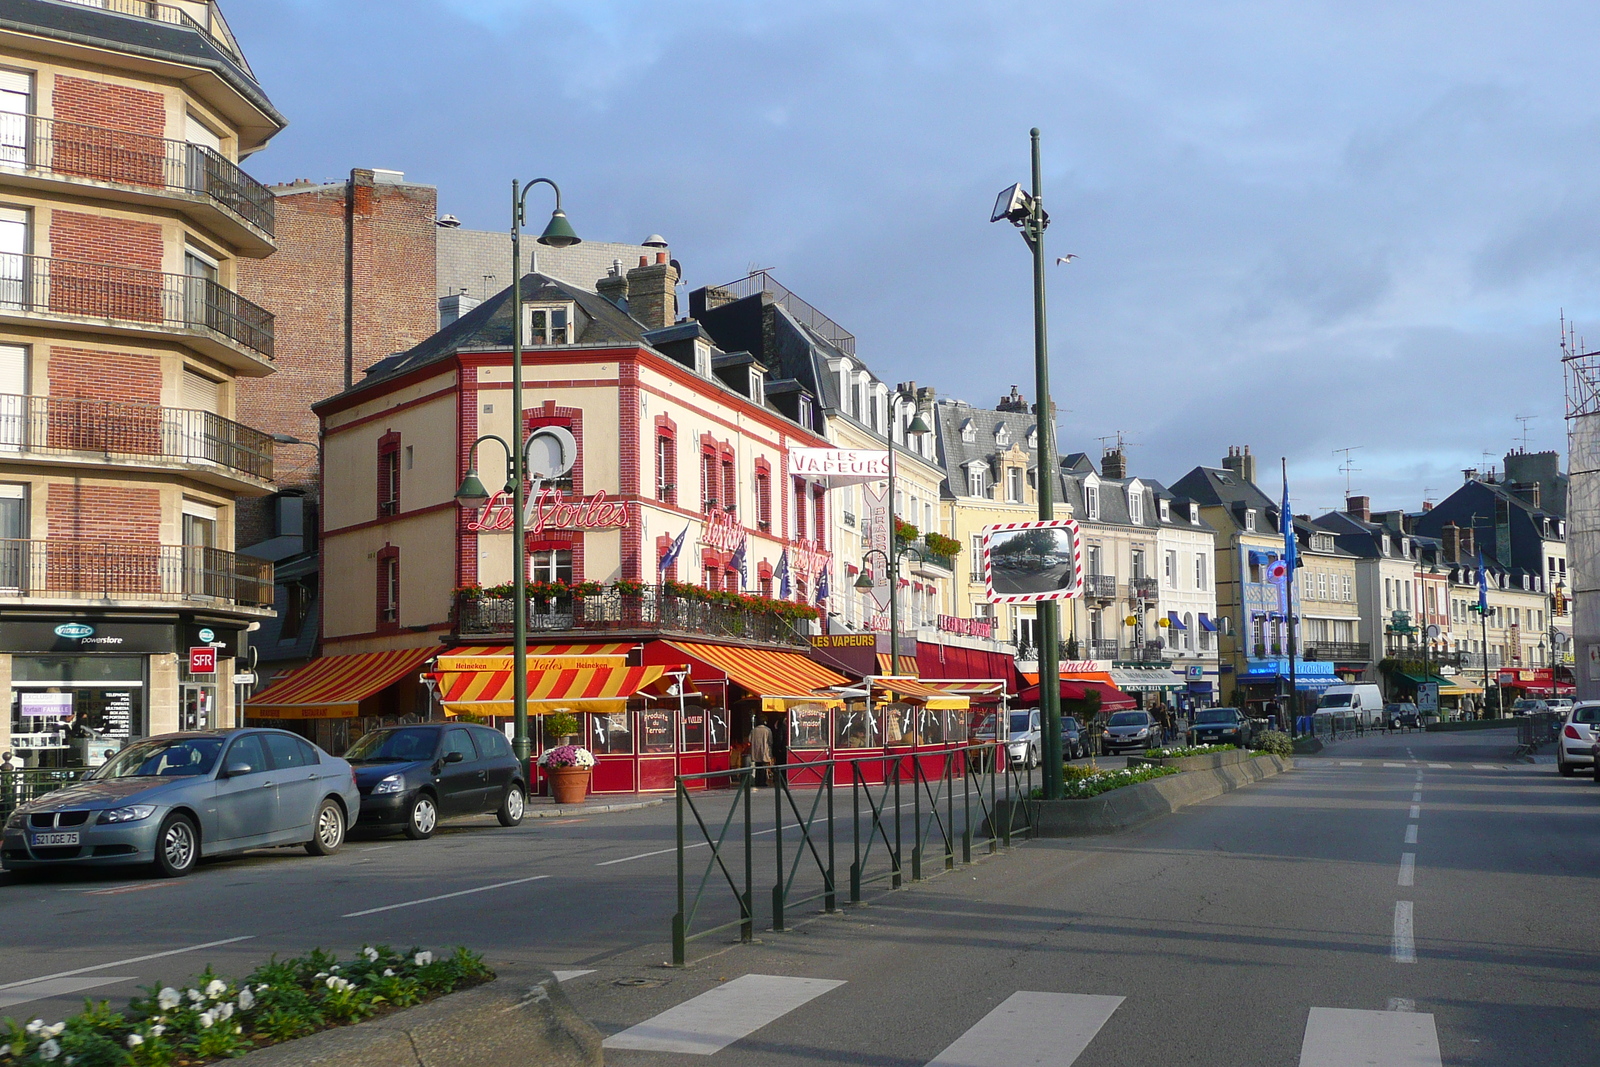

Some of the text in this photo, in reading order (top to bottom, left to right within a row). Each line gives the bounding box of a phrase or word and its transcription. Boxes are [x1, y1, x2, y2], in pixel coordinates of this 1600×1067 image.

[827, 452, 856, 461] LES
[793, 452, 890, 474] VAPEURS
[467, 488, 630, 534] Le Voiles
[81, 635, 123, 644] powerstore
[812, 635, 875, 647] LES VAPEURS
[193, 654, 212, 666] SFR
[502, 659, 515, 670] Le
[644, 711, 668, 722] produits
[67, 834, 78, 843] 75
